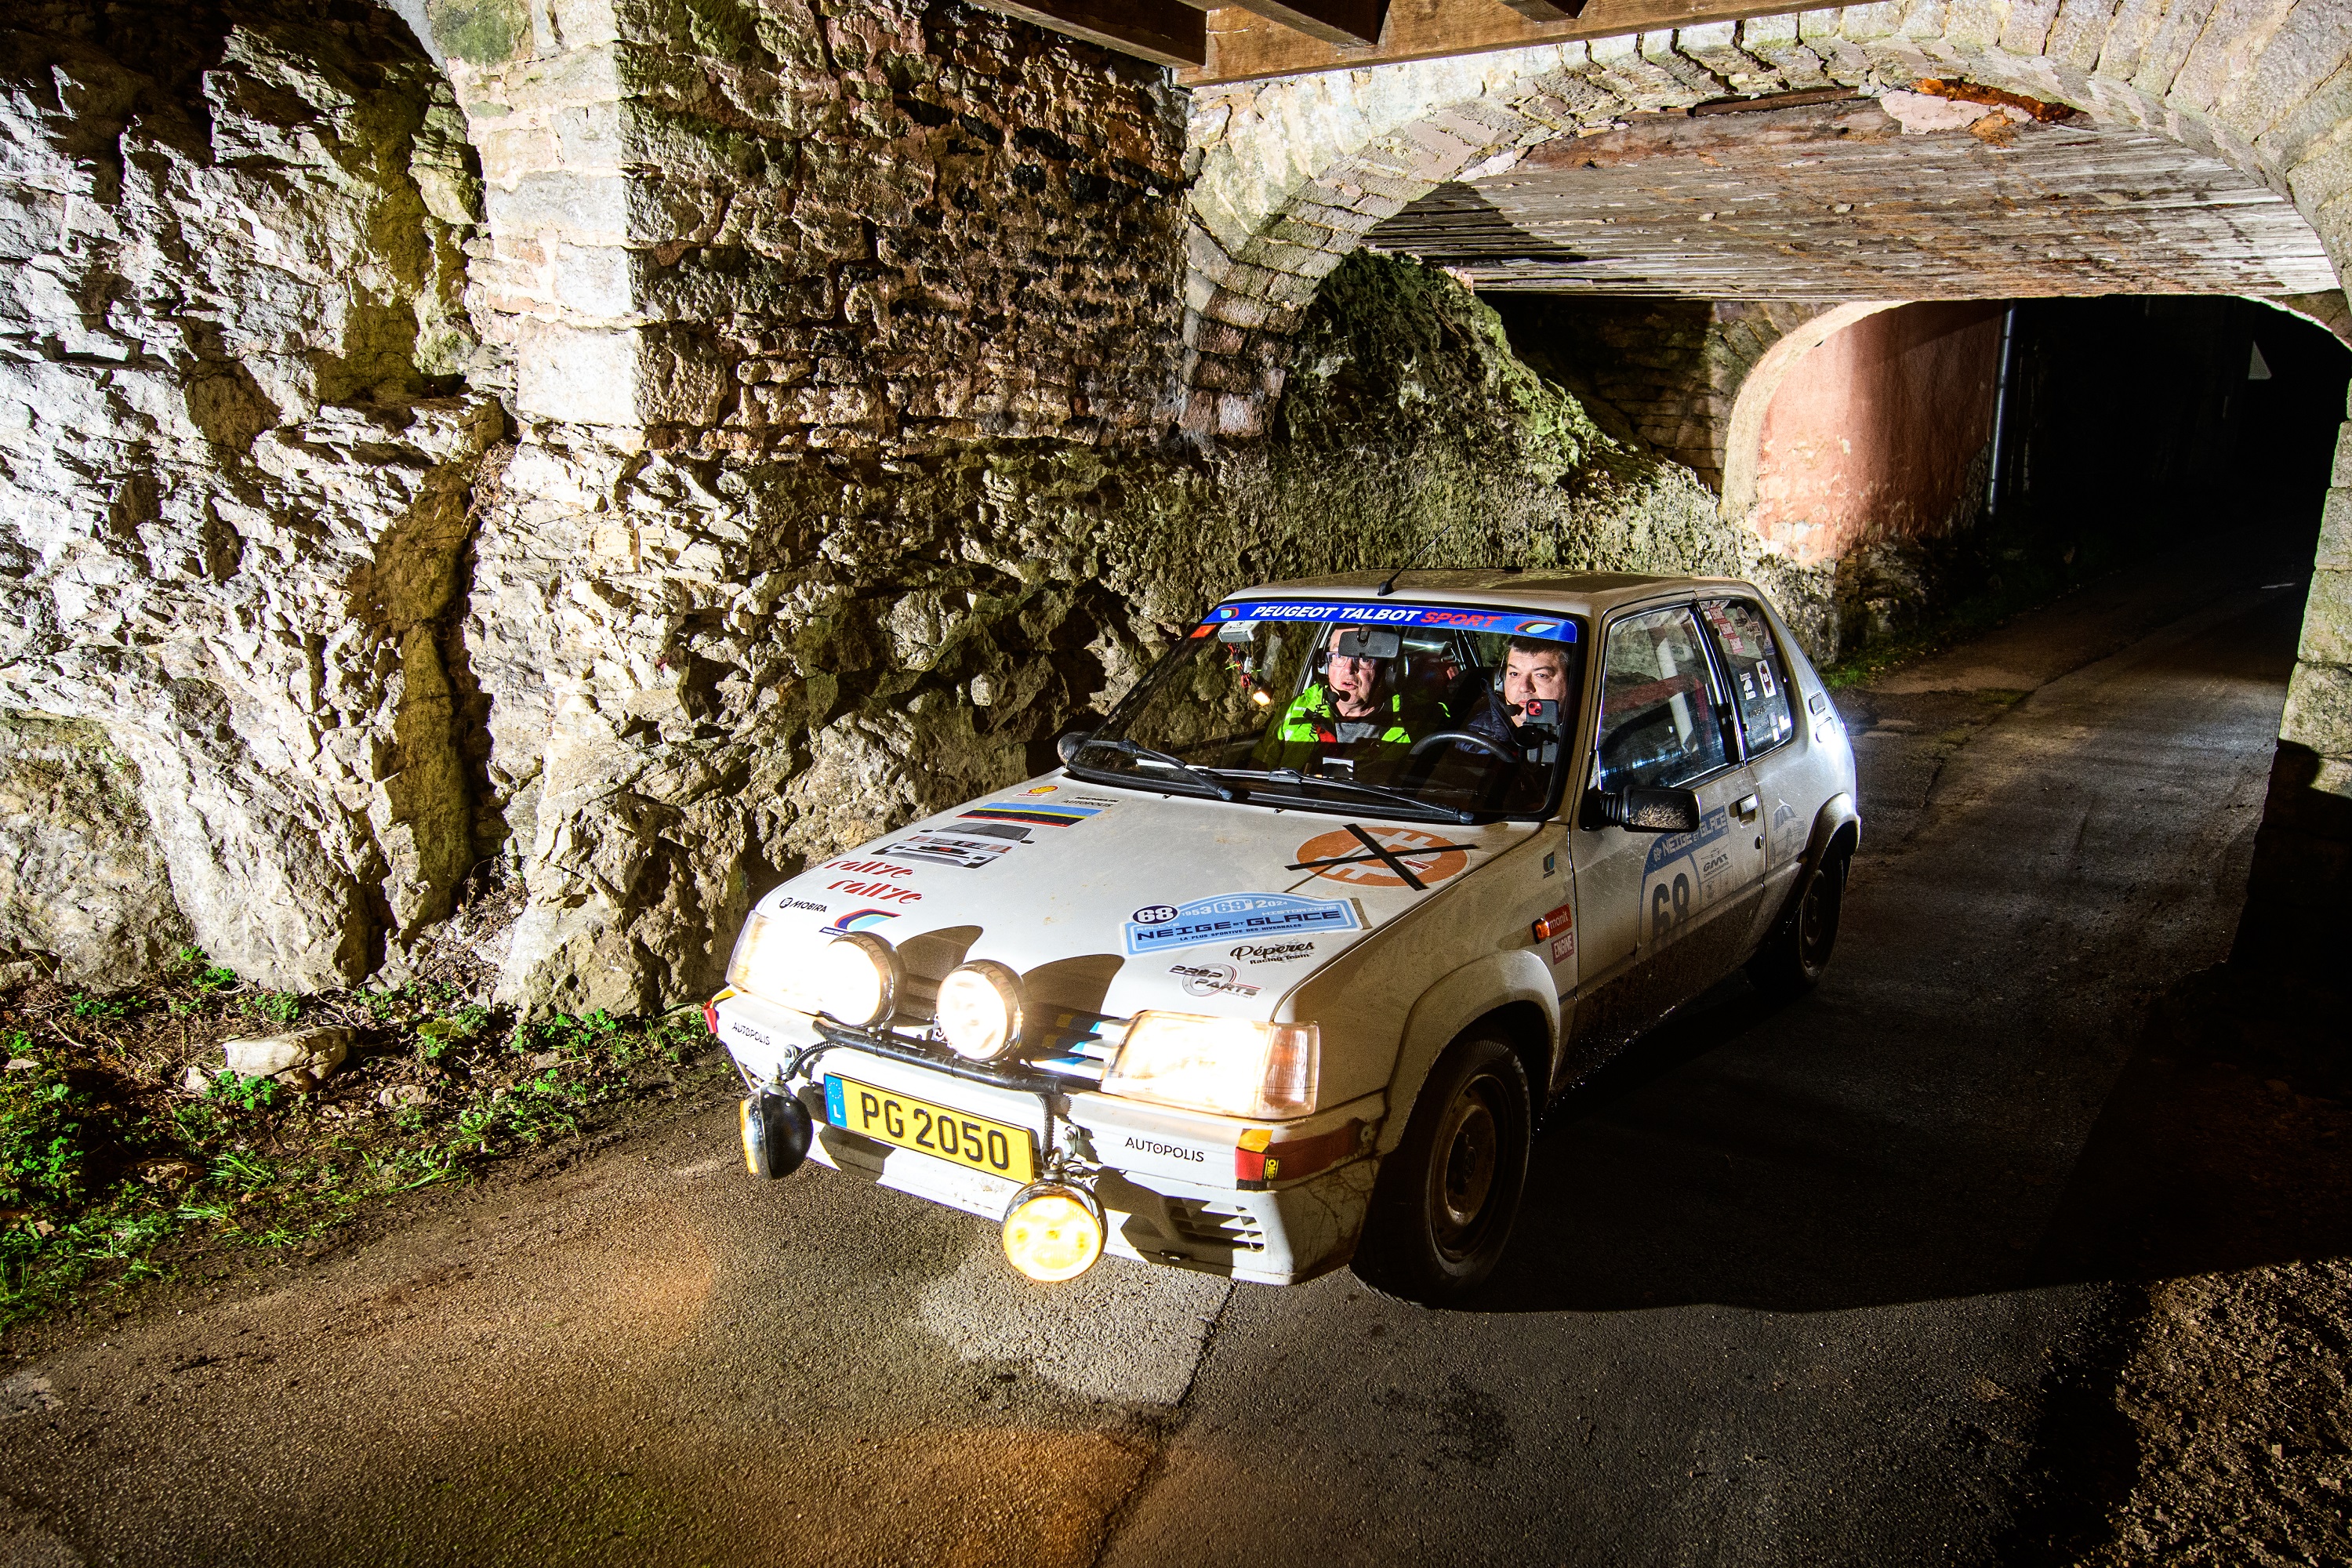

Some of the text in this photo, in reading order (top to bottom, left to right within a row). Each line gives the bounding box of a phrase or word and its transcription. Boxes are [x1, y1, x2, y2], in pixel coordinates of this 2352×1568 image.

[1250, 605, 1502, 627] PEUGEOT TALBOT SPORT
[1662, 833, 1693, 857] NEIGE
[1693, 832, 1700, 841] ET
[1700, 812, 1727, 837] GLACE
[823, 861, 913, 878] rallye
[1703, 853, 1729, 872] GMT
[826, 880, 923, 904] rallye
[789, 899, 828, 913] MOBIRA
[1137, 907, 1174, 923] 68
[1181, 906, 1212, 916] 1953
[1256, 900, 1287, 909] 2024
[1652, 873, 1690, 941] 68
[1137, 906, 1338, 931] RALLYE HISTORIQUE
[1138, 921, 1232, 941] NEIGE
[1247, 911, 1341, 926] GLACE
[1549, 912, 1569, 930] monit
[1229, 941, 1315, 961] Pépères
[1553, 934, 1573, 959] ENGINE
[1250, 956, 1283, 965] Racing
[1169, 965, 1224, 978] PRÉP
[1194, 978, 1258, 996] PARTS
[731, 1022, 770, 1046] AUTOPOLIS
[833, 1091, 1010, 1170] L PG 2050
[1124, 1137, 1204, 1162] AUTOPOLIS
